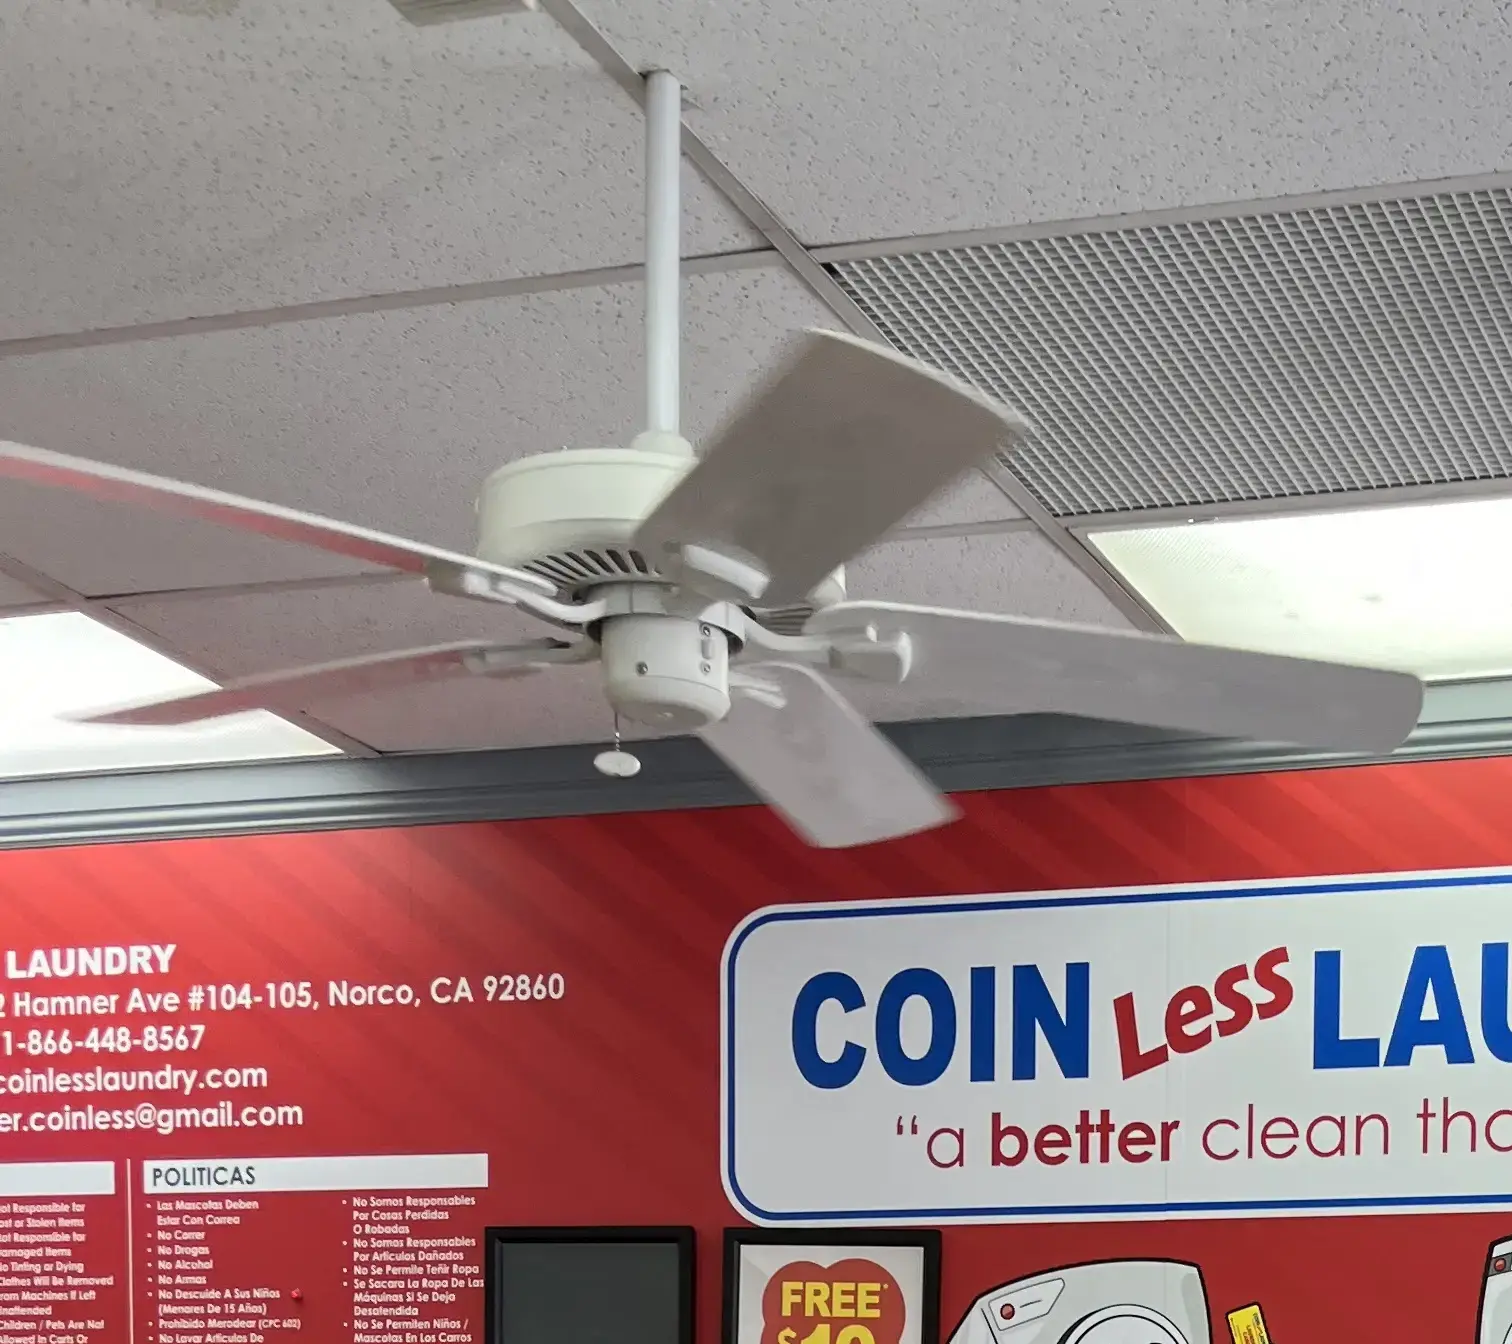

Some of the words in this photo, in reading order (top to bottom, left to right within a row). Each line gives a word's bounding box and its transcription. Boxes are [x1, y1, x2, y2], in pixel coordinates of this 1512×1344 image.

[6, 943, 176, 979] LAUNDRY
[13, 991, 119, 1017] Hamner
[125, 987, 180, 1013] Ave
[187, 981, 319, 1011] #104-105,
[328, 980, 420, 1007] Norco,
[430, 976, 473, 1003] CA
[483, 973, 564, 1001] 92860
[794, 963, 1090, 1089] COIN
[1115, 948, 1293, 1077] Less
[2, 1024, 205, 1055] 1-866-448-8567
[152, 1166, 255, 1187] POLITICAS
